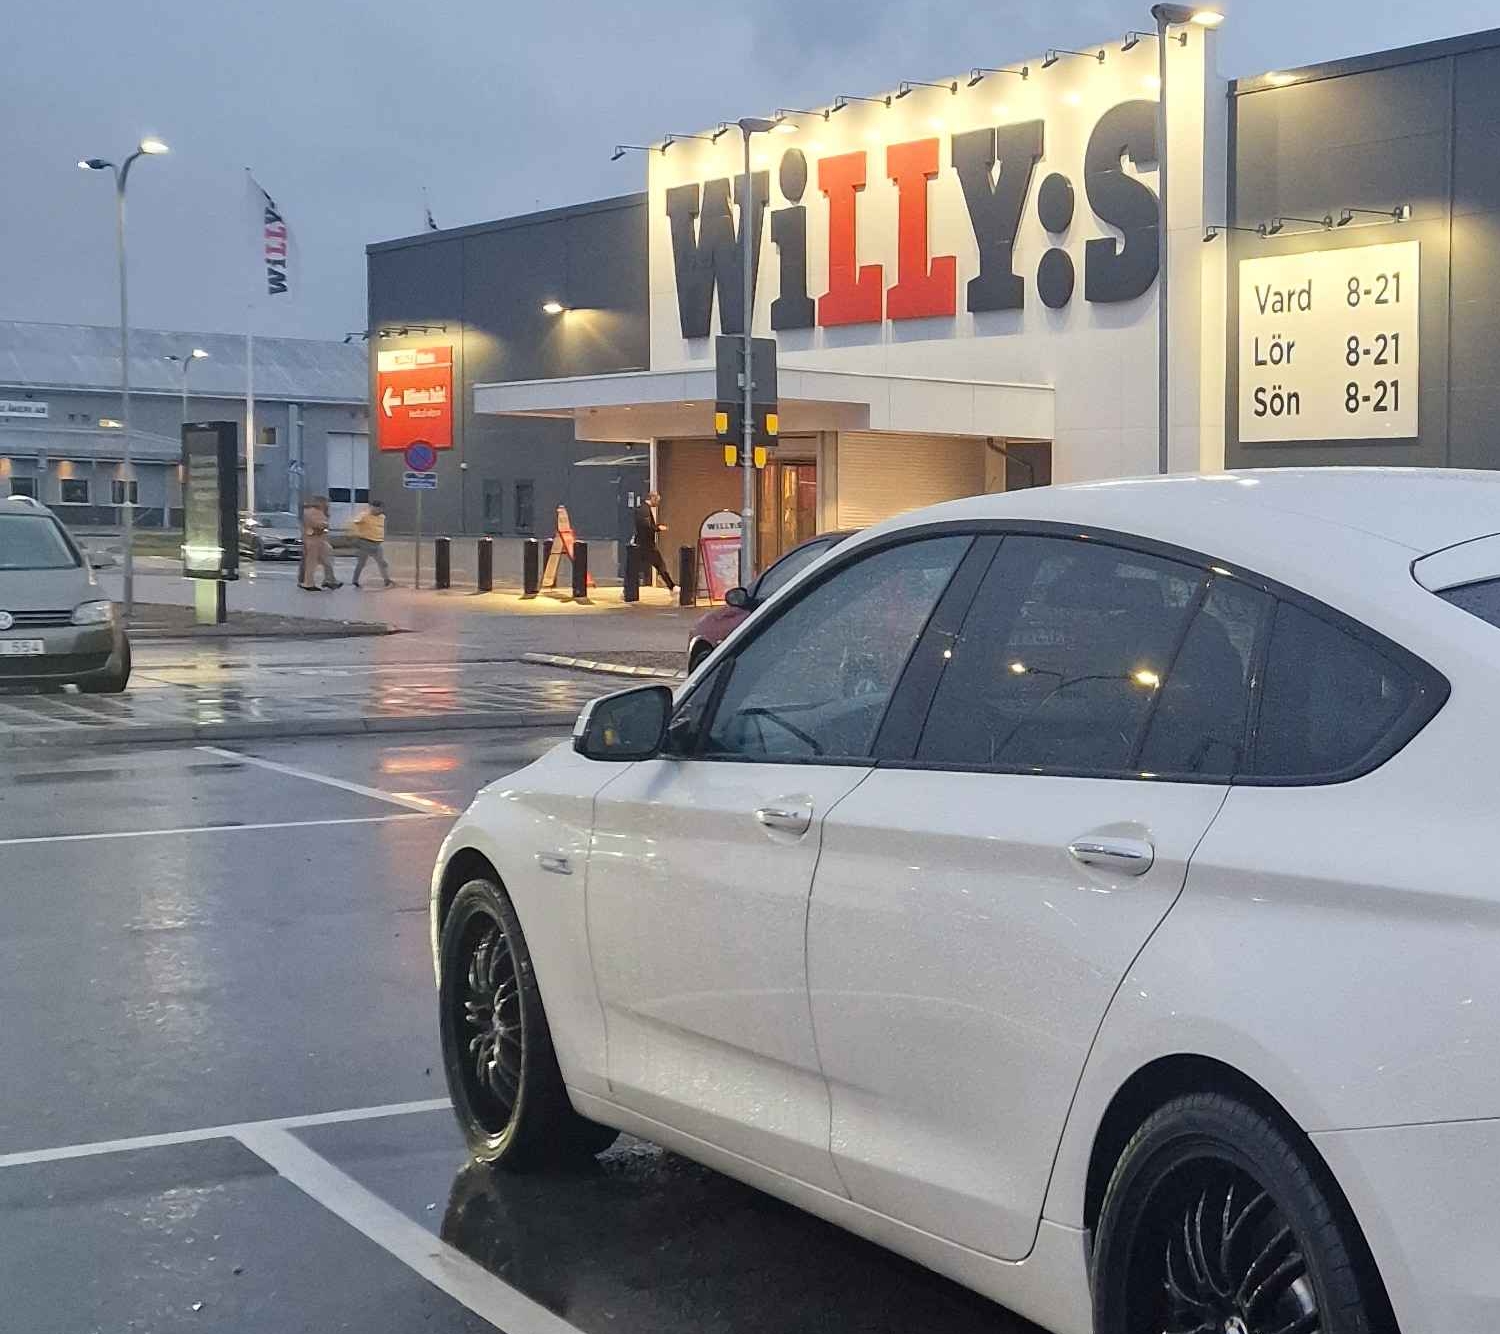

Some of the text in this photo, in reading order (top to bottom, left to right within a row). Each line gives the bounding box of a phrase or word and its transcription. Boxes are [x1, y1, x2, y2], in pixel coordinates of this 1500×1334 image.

[1255, 271, 1401, 315] Vard 8-21
[1254, 332, 1400, 367] Lör 8-21
[1253, 379, 1399, 417] Sön 8-21
